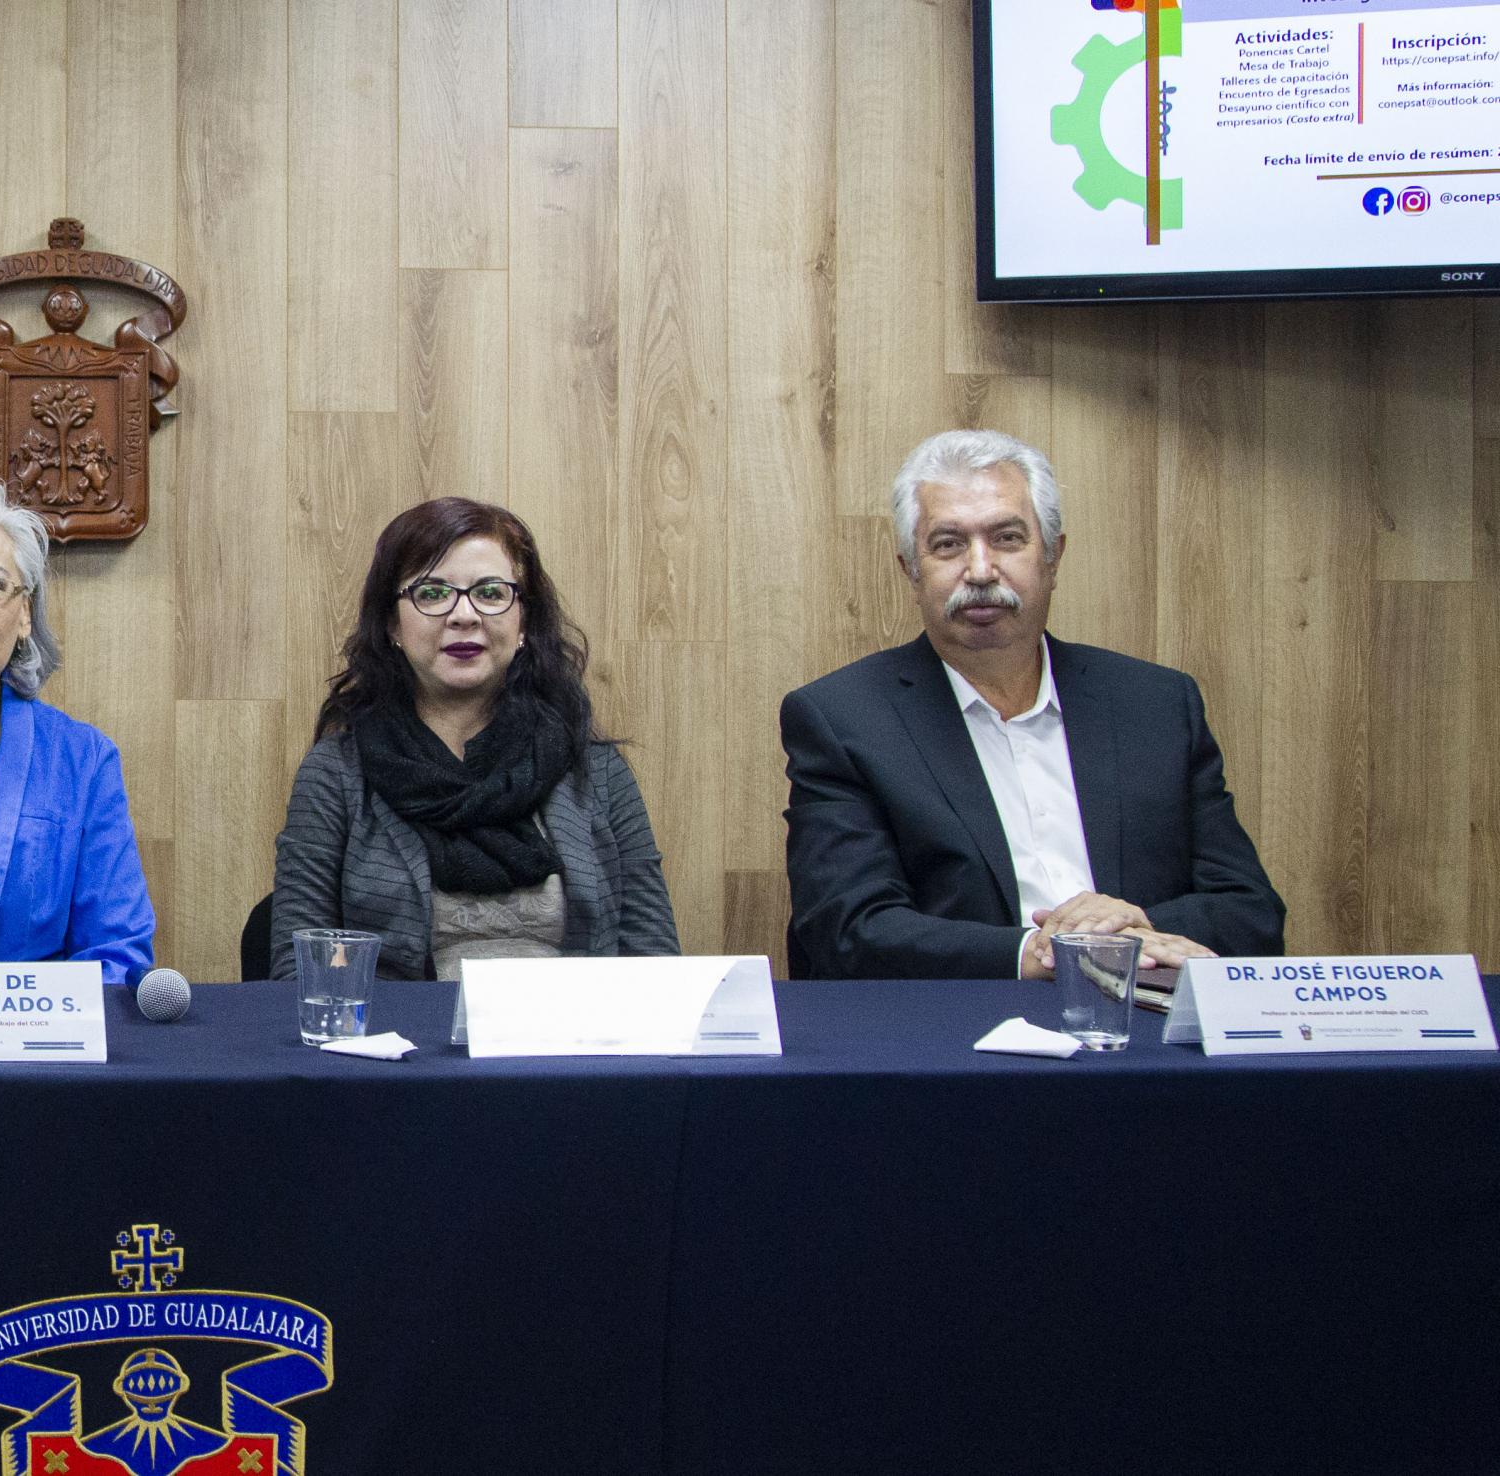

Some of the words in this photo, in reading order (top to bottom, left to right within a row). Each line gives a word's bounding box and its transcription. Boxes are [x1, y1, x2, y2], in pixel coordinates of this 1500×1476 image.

[1235, 28, 1333, 44] Actividades:
[1392, 33, 1486, 50] Inscripción:
[1239, 48, 1293, 58] Ponencias
[1297, 44, 1330, 55] Cartel
[1240, 62, 1268, 71] Mesa
[1272, 60, 1285, 70] de
[1289, 58, 1329, 71] Trabajo
[1220, 76, 1260, 86] Talleres
[1264, 75, 1277, 84] de
[1281, 72, 1349, 84] capacitación
[1398, 82, 1420, 92] Más
[1424, 80, 1494, 91] información:
[1219, 90, 1274, 100] Encuentro
[1277, 88, 1291, 97] de
[1294, 85, 1350, 98] Egresados
[1218, 103, 1272, 114] Desayuno
[1329, 100, 1349, 108] con
[1216, 116, 1283, 128] empresarios
[1286, 114, 1320, 126] (Costo
[1323, 112, 1354, 123] extra)
[1264, 155, 1301, 166] Fecha
[1348, 152, 1364, 163] de
[1410, 148, 1426, 160] de
[1430, 146, 1494, 159] resúmen:
[79, 252, 181, 302] GUADALAJAR
[1441, 272, 1485, 282] SONY
[1226, 966, 1264, 980] DR.
[1271, 962, 1326, 980] JOSÉ
[1332, 966, 1444, 980] FIGUEROA
[6, 975, 36, 990] DE
[1295, 986, 1388, 1001] CAMPOS
[62, 997, 82, 1012] S.
[128, 1303, 156, 1328] DE
[164, 1302, 320, 1348] GUADALAJARA
